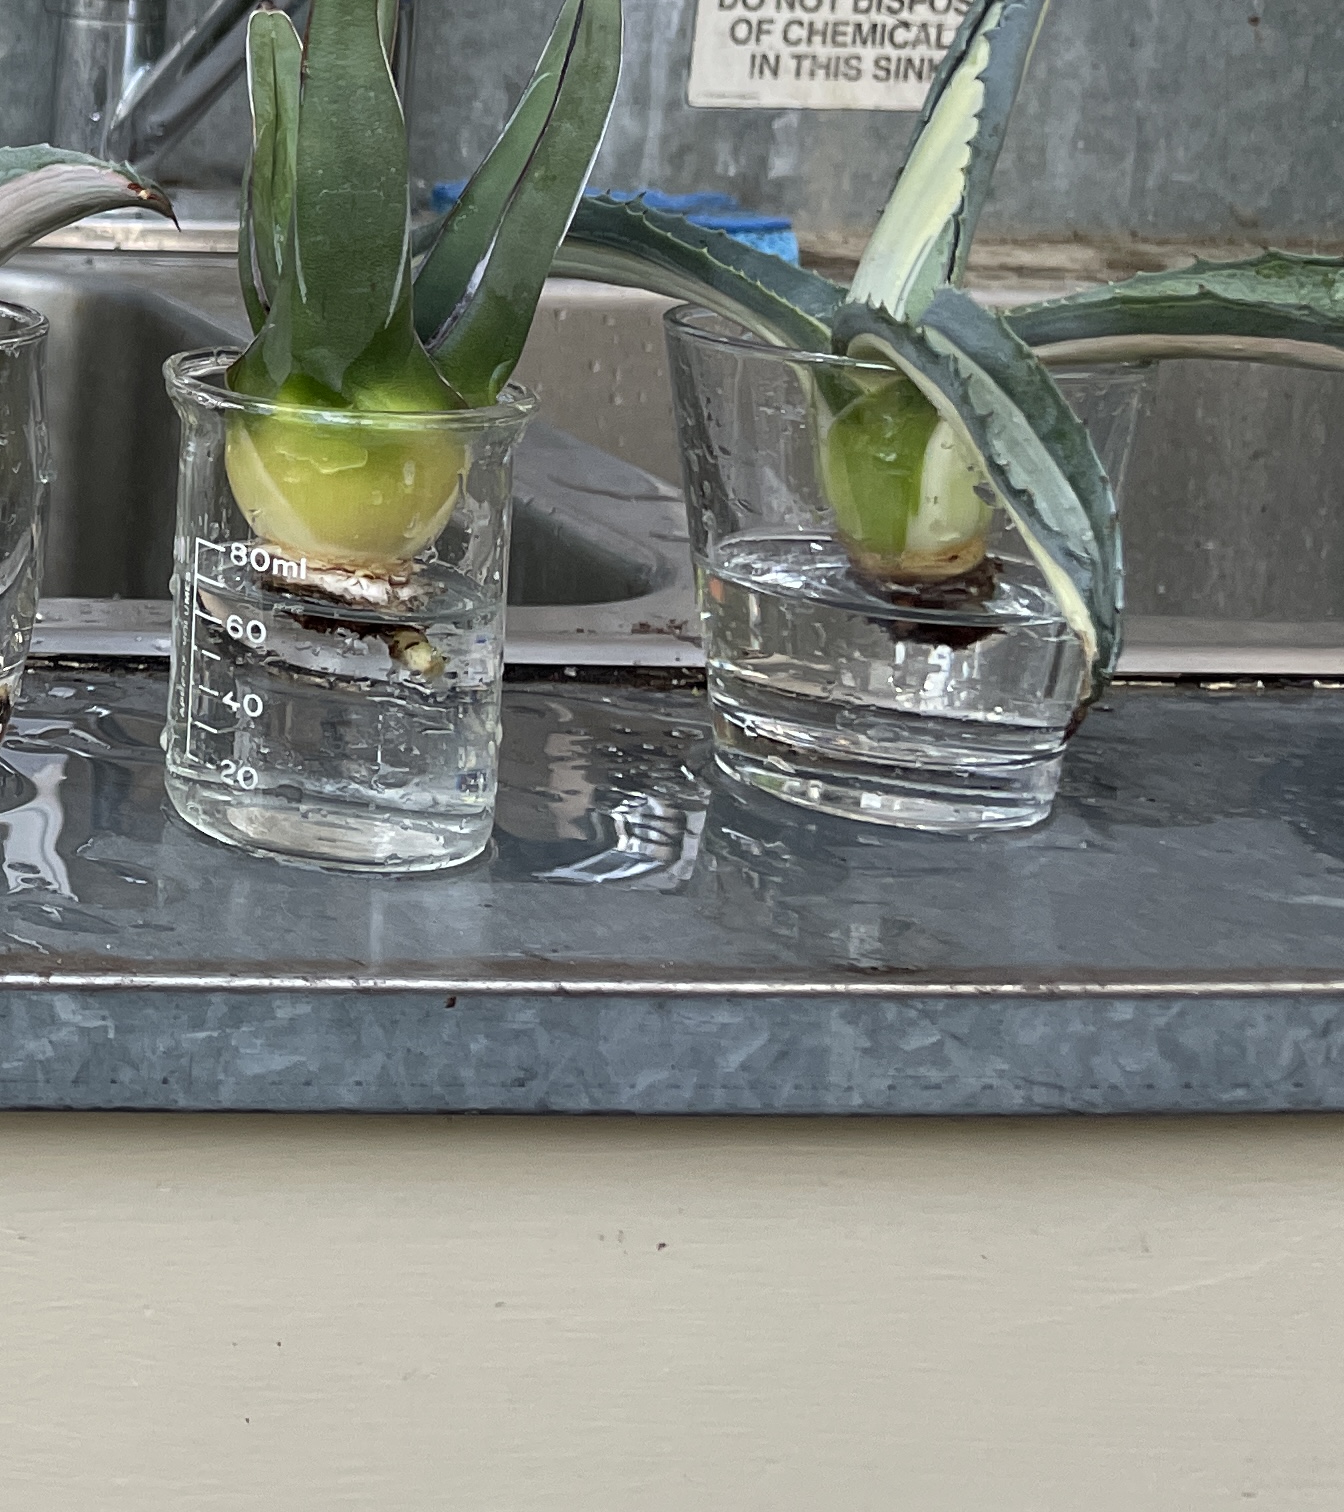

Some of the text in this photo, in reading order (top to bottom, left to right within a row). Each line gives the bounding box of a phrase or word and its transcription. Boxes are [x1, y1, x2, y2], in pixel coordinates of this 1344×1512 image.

[729, 18, 954, 50] OF CHEMICAL
[749, 53, 781, 80] IN
[789, 54, 863, 81] THIS
[230, 542, 307, 580] 80ml
[226, 614, 267, 644] 60
[222, 690, 263, 717] 40
[220, 759, 259, 790] 20
